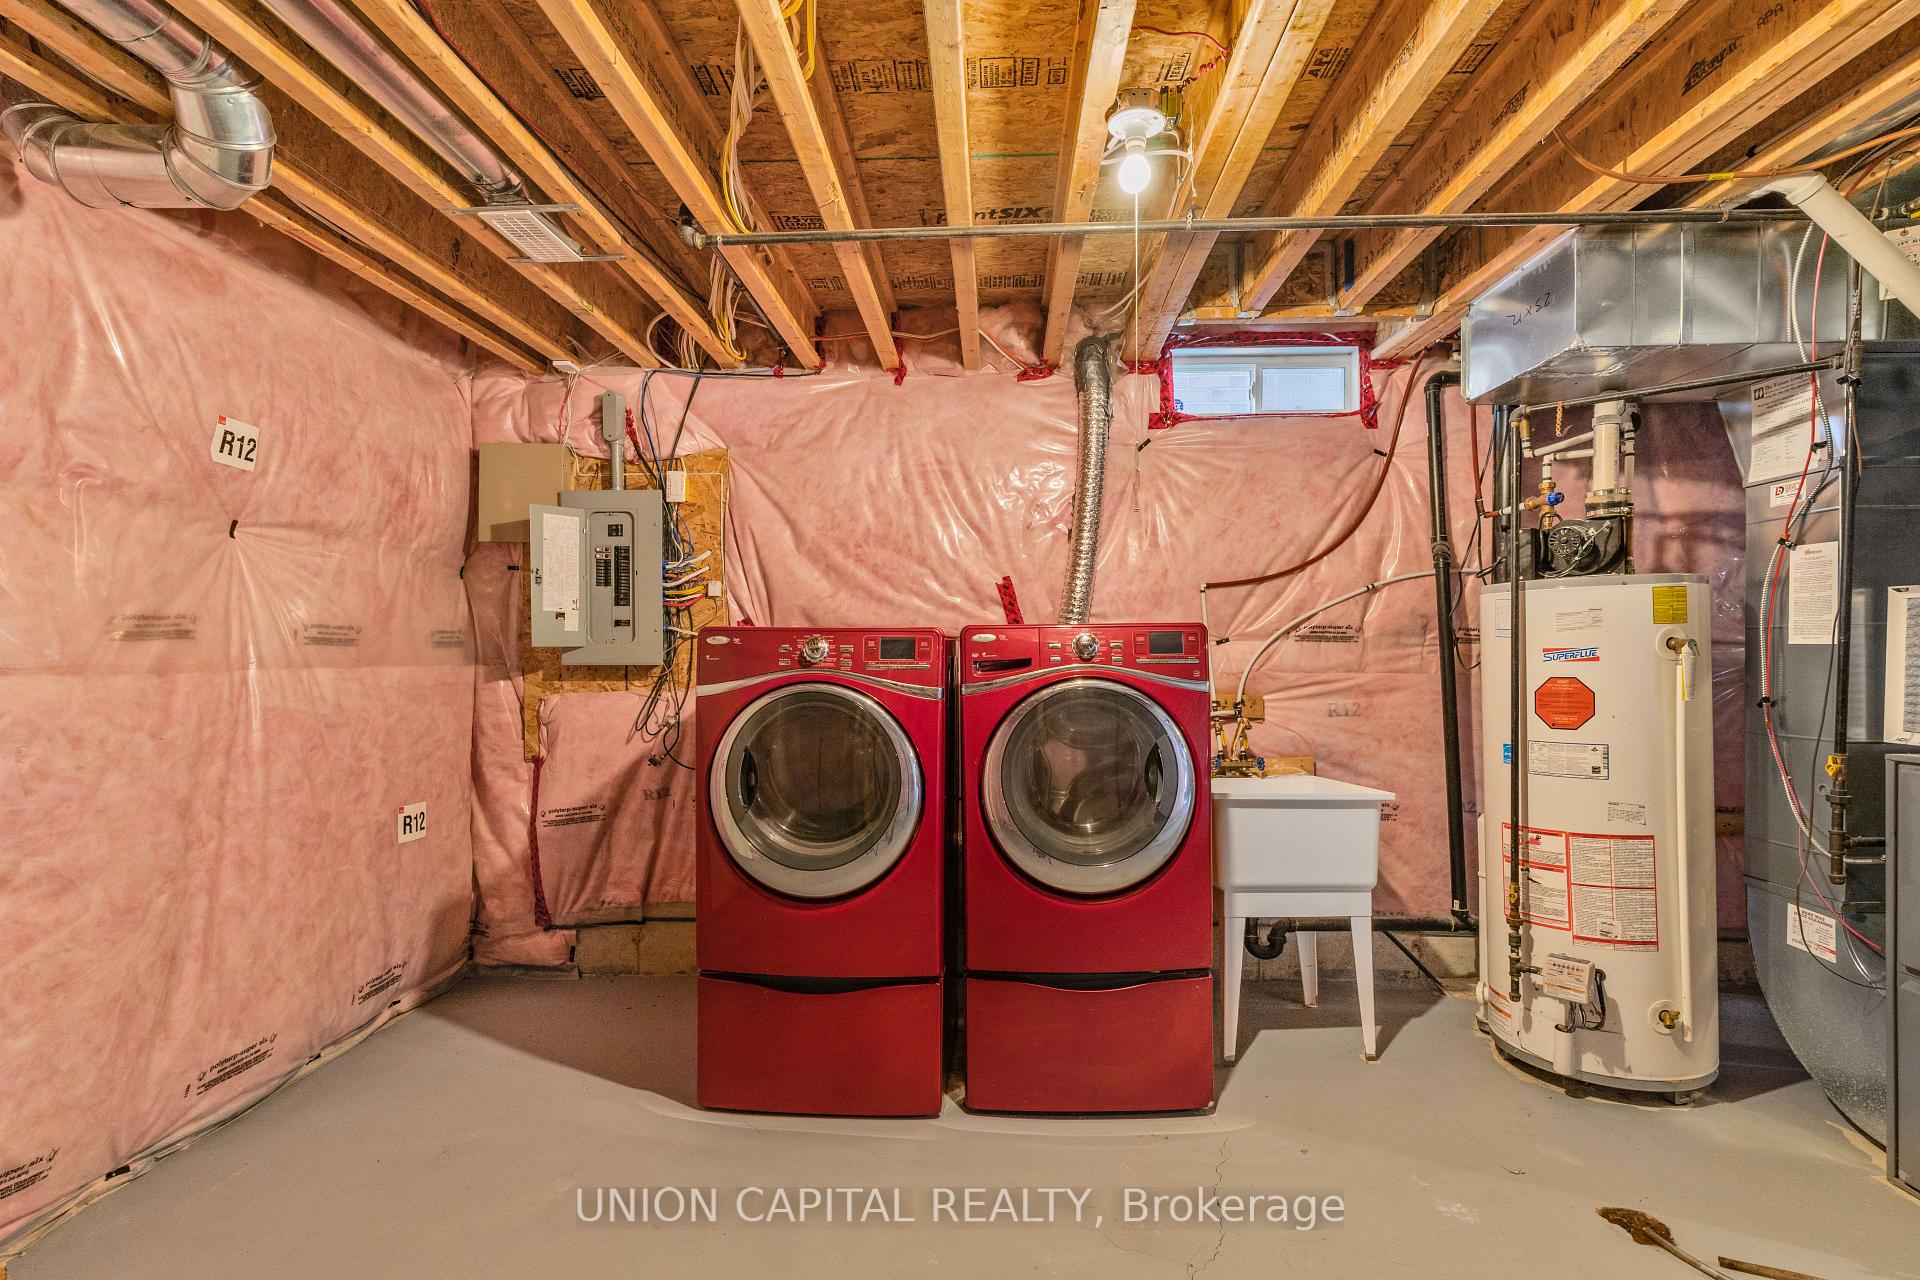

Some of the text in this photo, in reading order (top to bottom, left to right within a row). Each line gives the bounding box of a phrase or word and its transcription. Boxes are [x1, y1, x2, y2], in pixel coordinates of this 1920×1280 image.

[219, 429, 256, 463] R12
[1327, 702, 1361, 718] R12
[403, 811, 425, 835] R12
